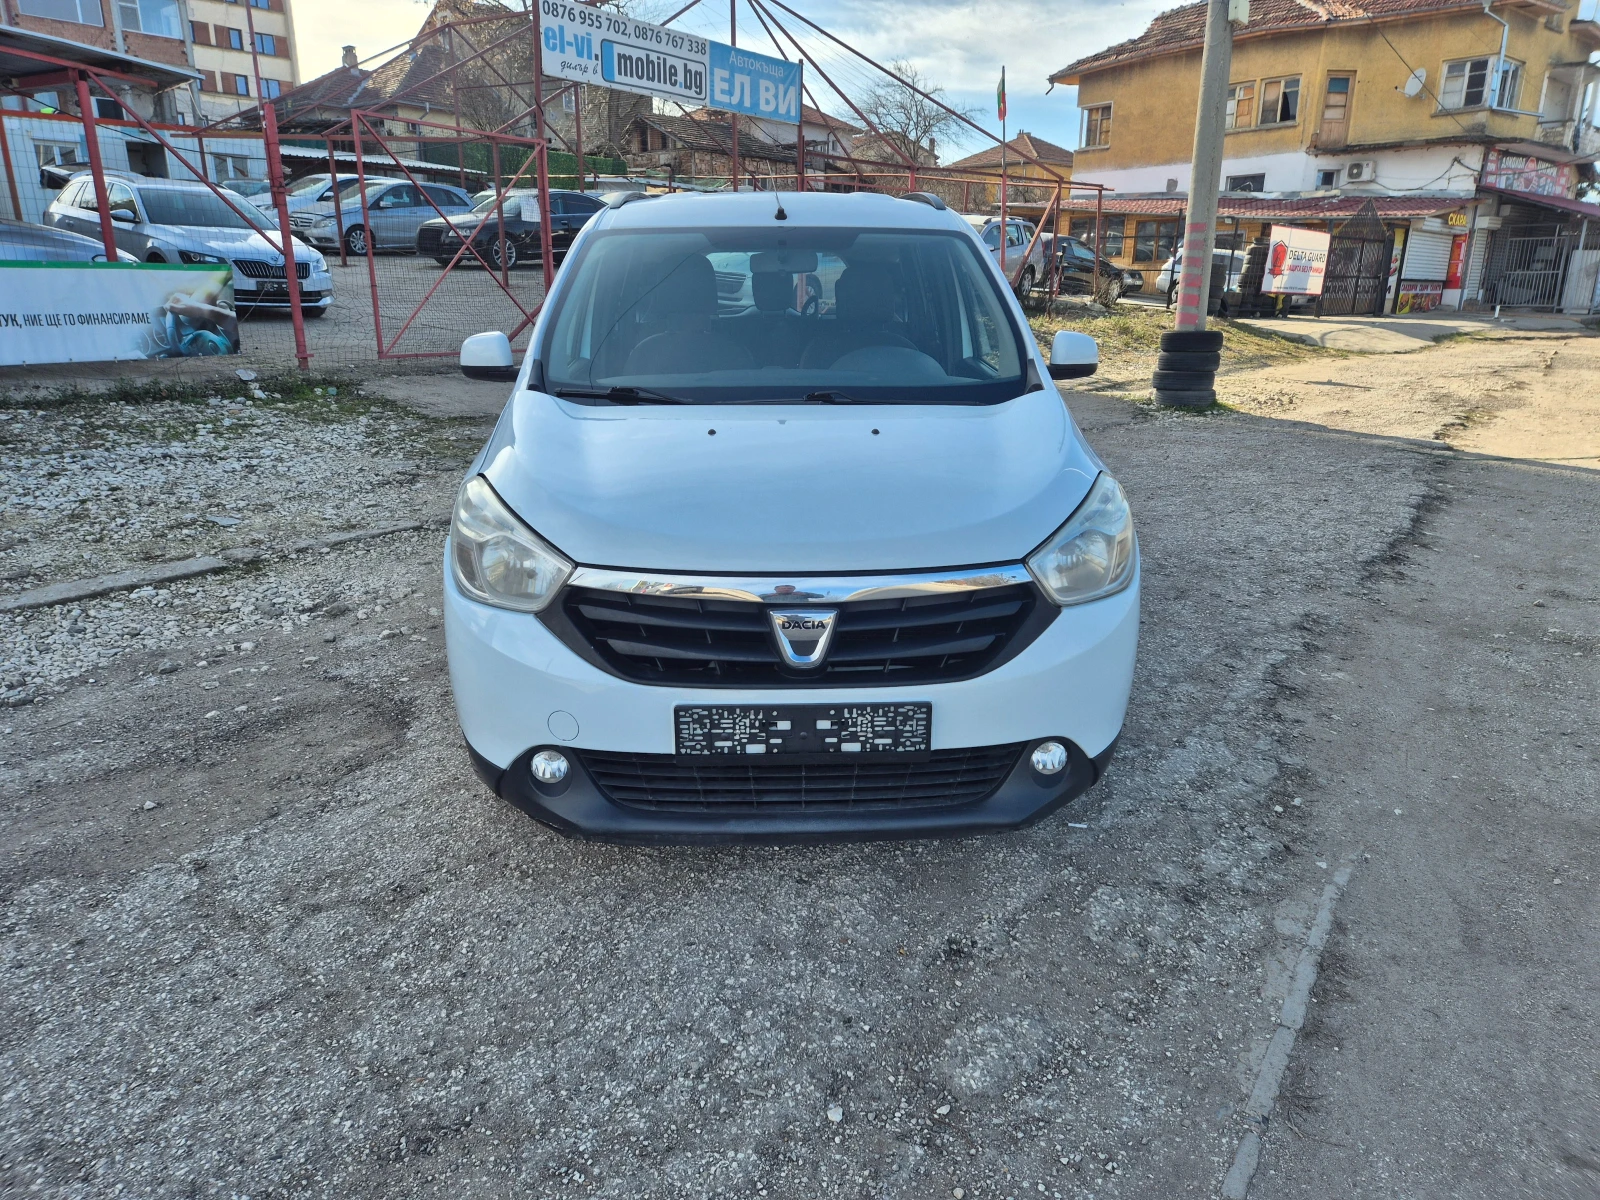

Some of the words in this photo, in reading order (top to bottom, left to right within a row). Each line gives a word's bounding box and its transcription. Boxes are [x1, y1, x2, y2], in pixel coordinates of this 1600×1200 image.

[542, 0, 576, 23] 0876
[579, 10, 602, 30] 955
[605, 17, 631, 39] 702,
[634, 25, 663, 44] 0876
[665, 32, 685, 50] 767
[687, 38, 707, 56] 338
[560, 60, 589, 76] дилър
[729, 50, 784, 77] Автокъща
[713, 67, 751, 108] ЕЛ
[760, 78, 796, 117] ВИ
[1288, 249, 1307, 262] DELTA
[1307, 252, 1326, 263] GUARD
[23, 313, 44, 327] НИЕ
[45, 313, 62, 328] ЩЕ
[64, 313, 76, 326] ГО
[77, 312, 151, 326] ФИНАНСИРАМЕ
[781, 620, 826, 630] DACIA
